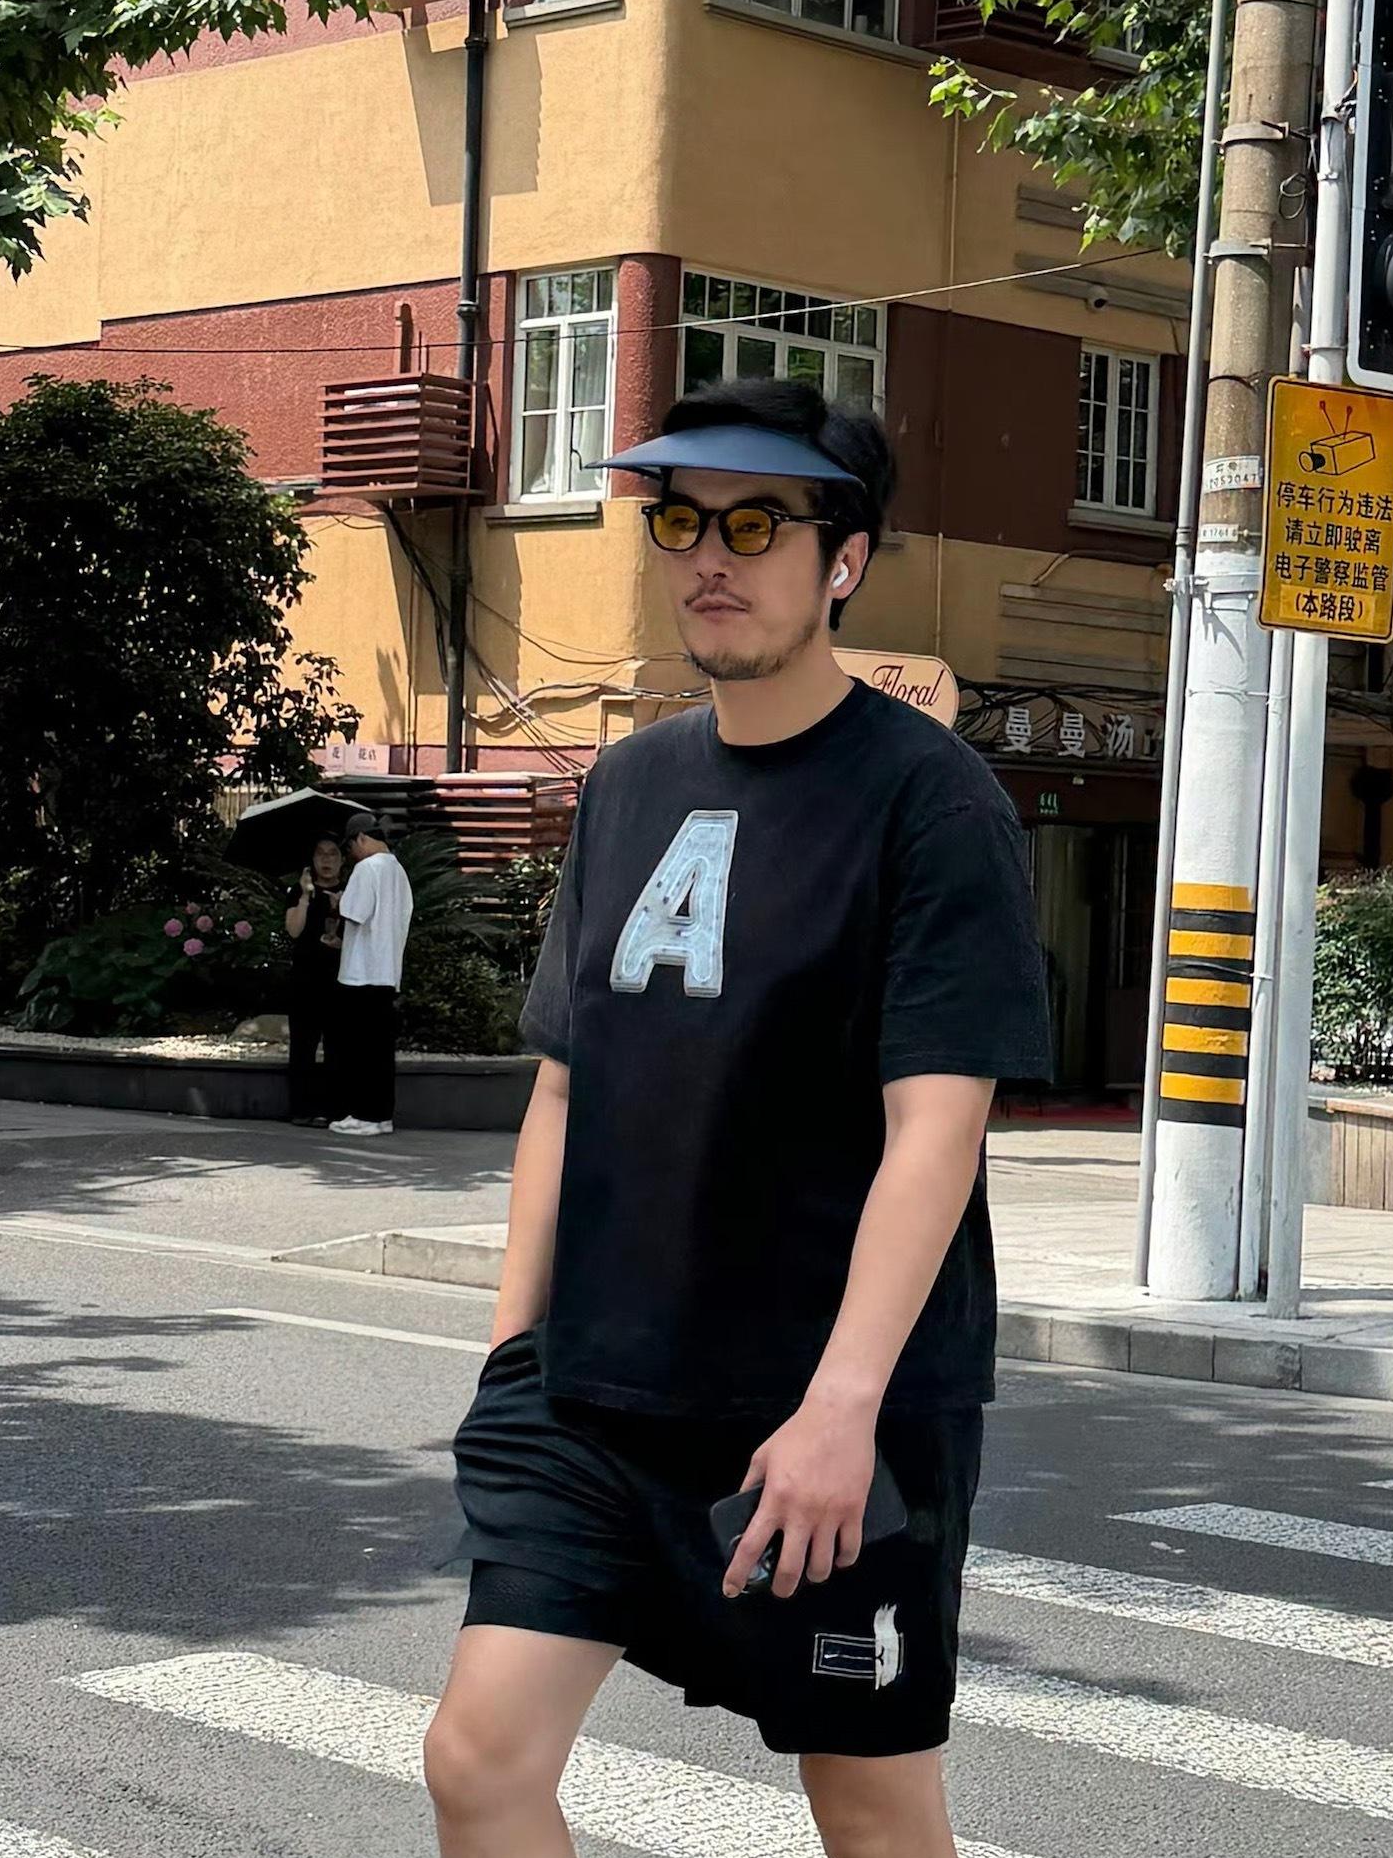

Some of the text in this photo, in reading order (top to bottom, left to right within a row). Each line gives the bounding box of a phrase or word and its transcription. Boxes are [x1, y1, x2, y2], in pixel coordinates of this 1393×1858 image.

[1276, 480, 1393, 523] 停车行为违法
[1285, 517, 1382, 555] 请立即驶离
[1274, 552, 1390, 592] 电子警察监管
[1294, 592, 1364, 623] (本路段)
[871, 664, 945, 707] Floral
[609, 809, 739, 999] A
